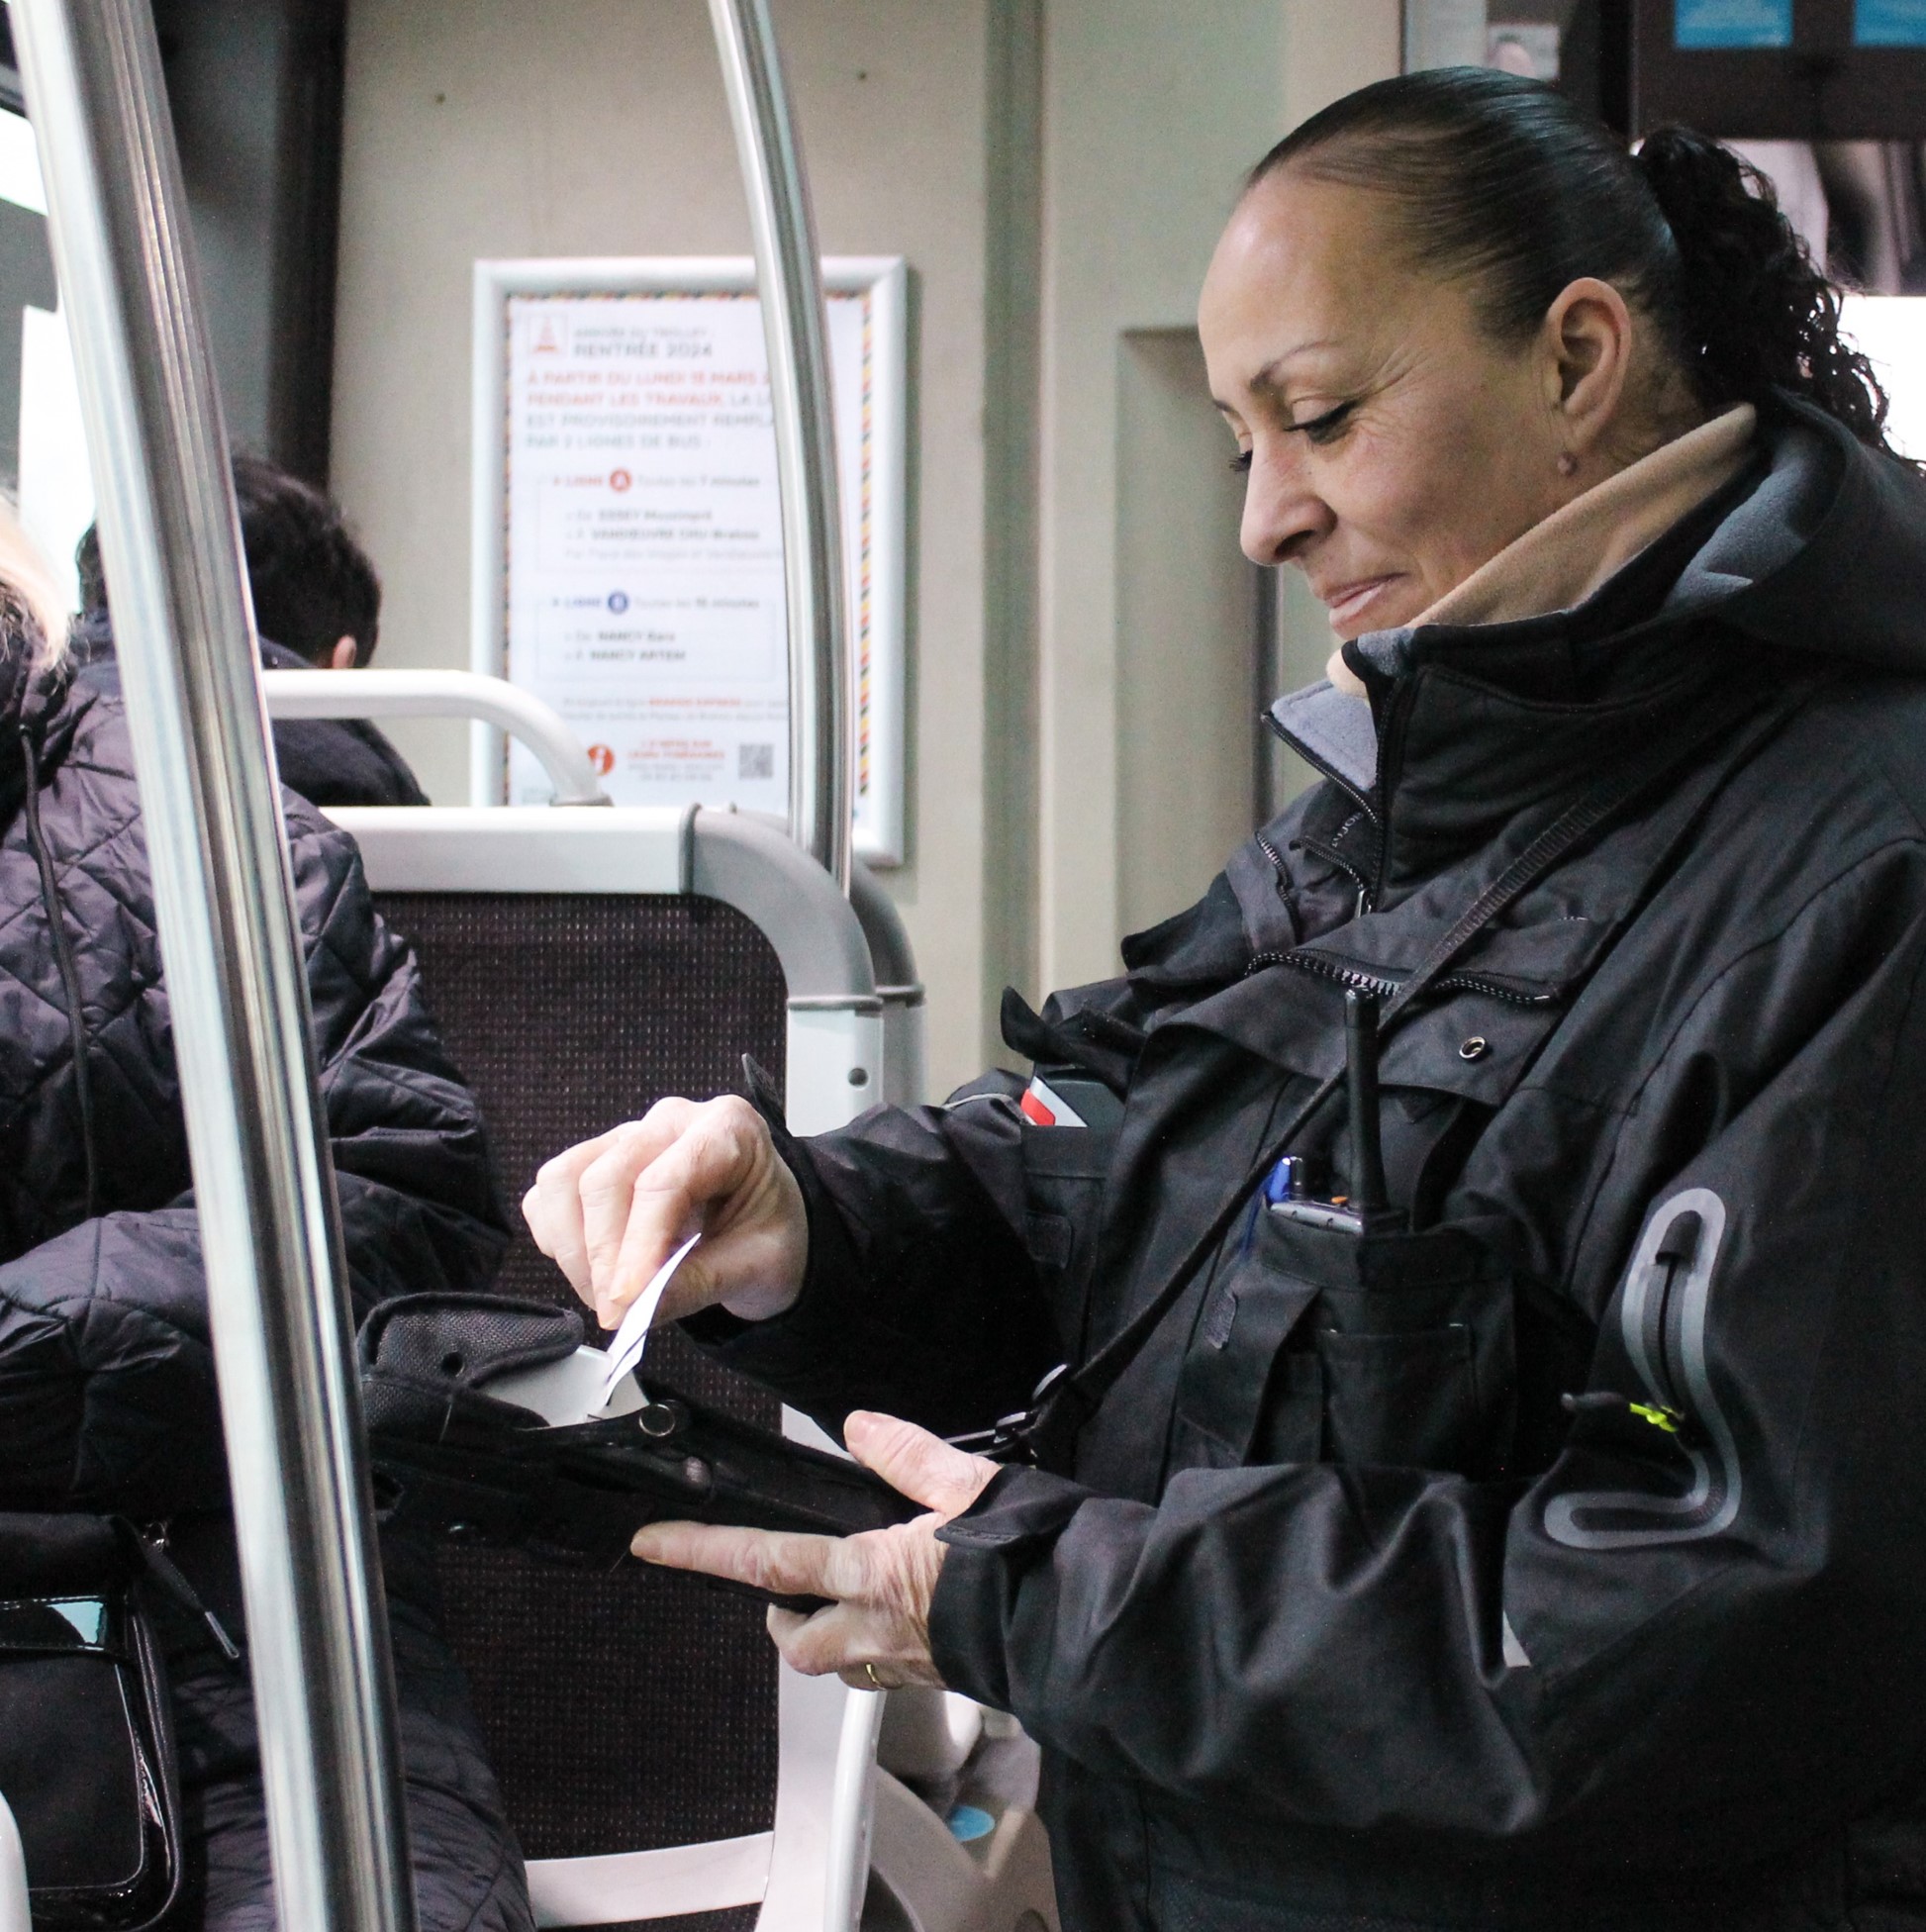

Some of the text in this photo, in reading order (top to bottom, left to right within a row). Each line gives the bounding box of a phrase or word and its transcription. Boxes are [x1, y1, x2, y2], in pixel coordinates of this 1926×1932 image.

[574, 340, 713, 358] RENTRÉE 2024
[542, 372, 602, 384] PARTIR
[607, 372, 632, 385] DU
[635, 372, 685, 385] LUNDI
[711, 371, 757, 384] MARS
[528, 393, 604, 406] PENDANT
[610, 394, 639, 406] LES
[731, 394, 751, 406] LA
[527, 414, 555, 426] EST
[561, 414, 708, 427] PROVISOIREMENT
[526, 435, 702, 447] PAR 2 LIGNES DE BUS
